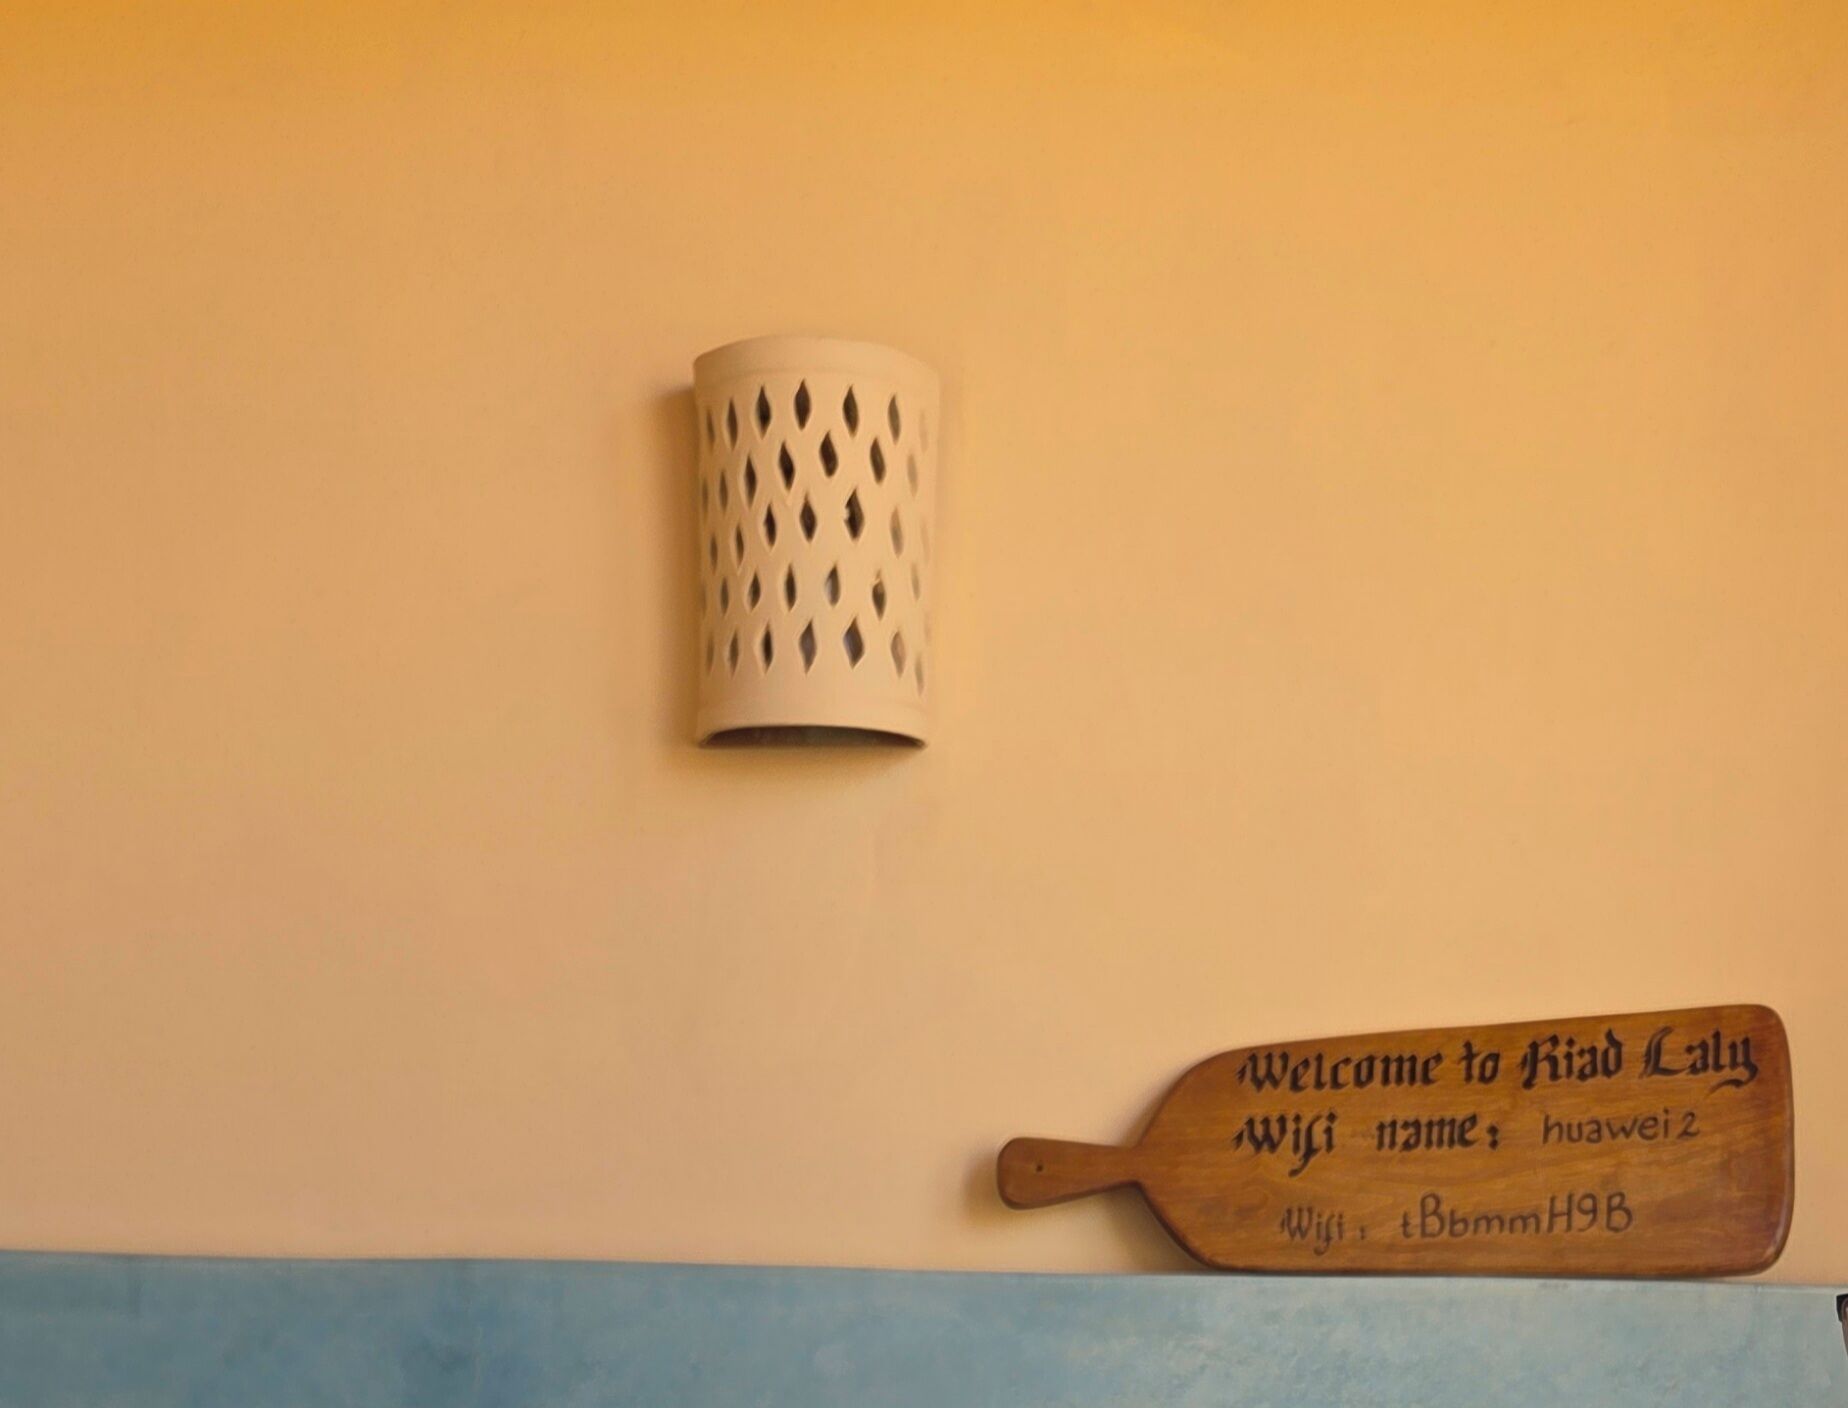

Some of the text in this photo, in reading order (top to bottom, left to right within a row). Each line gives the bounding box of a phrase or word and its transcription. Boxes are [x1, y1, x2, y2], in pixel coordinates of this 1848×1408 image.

[1235, 1025, 1759, 1097] Welcome to Riad Laly
[1232, 1106, 1338, 1177] Wifi
[1400, 1190, 1634, 1239] tBbmmH9B
